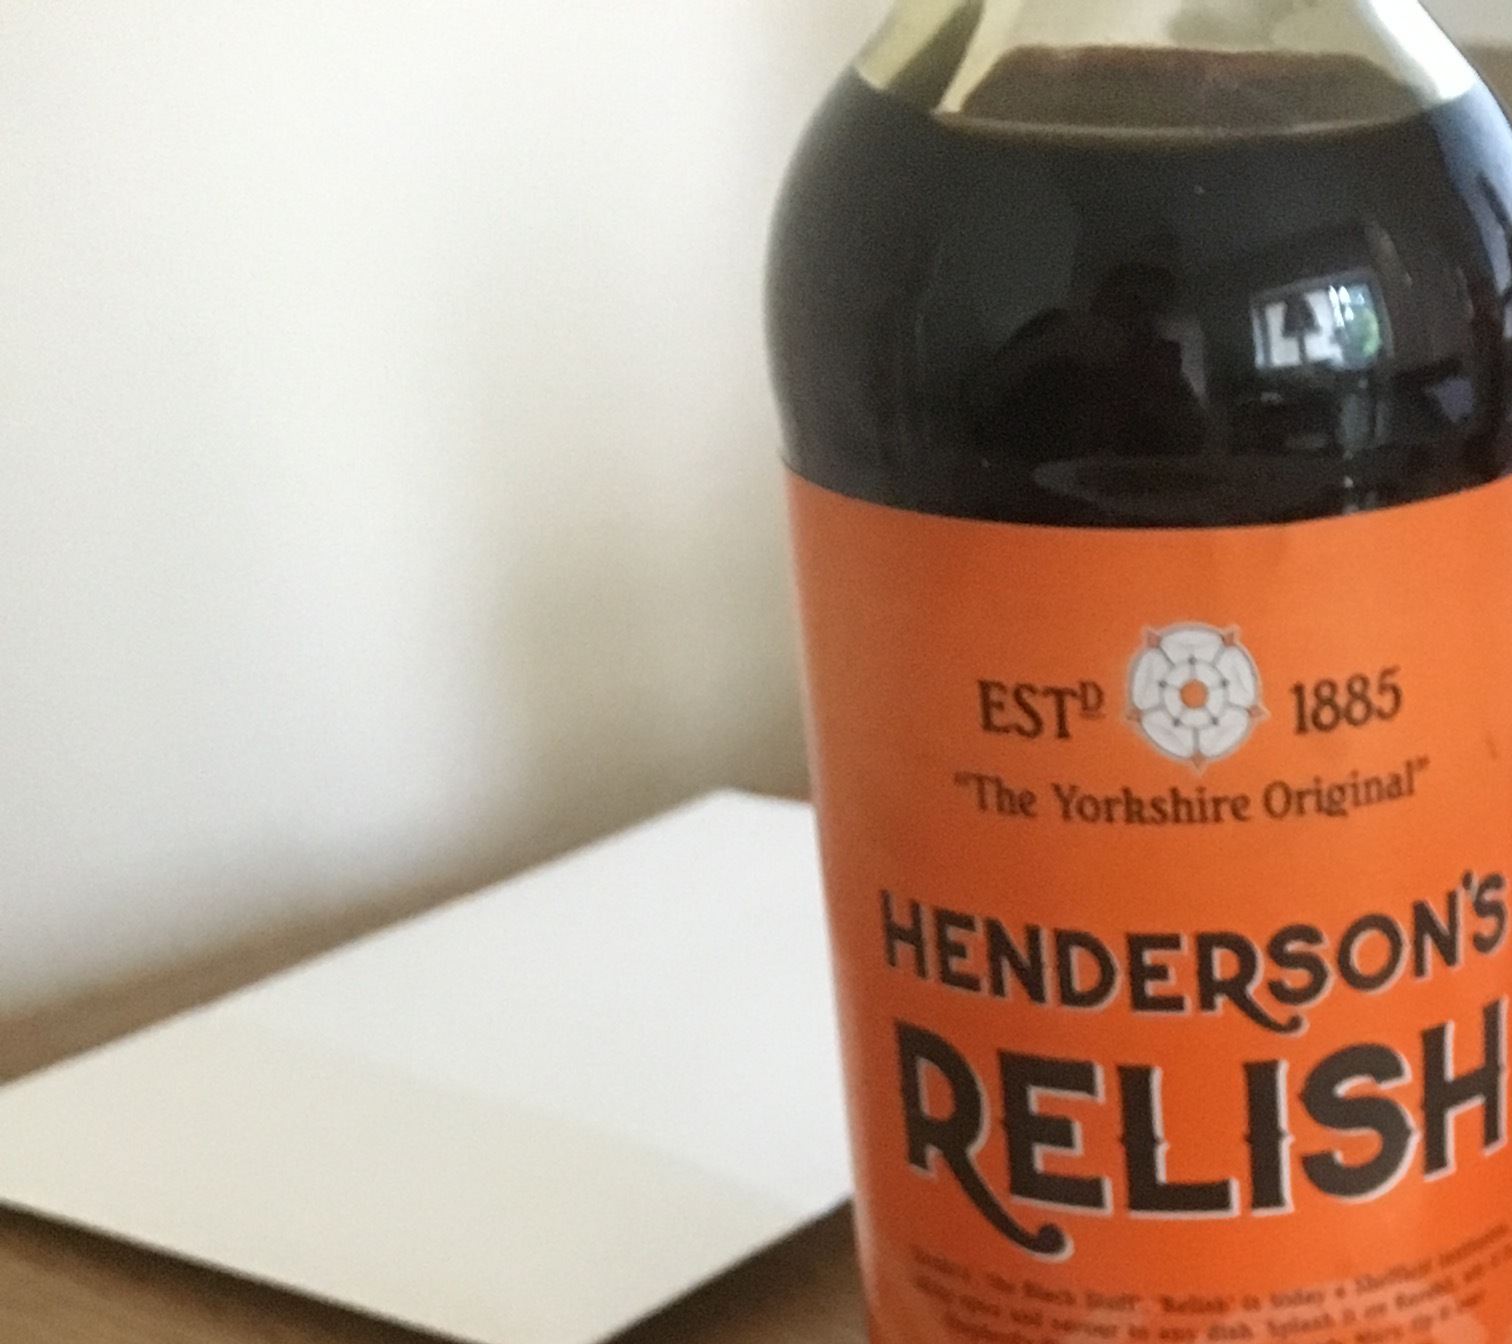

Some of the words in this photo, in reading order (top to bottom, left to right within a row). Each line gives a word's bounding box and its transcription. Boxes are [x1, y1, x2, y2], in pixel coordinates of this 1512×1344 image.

[1291, 666, 1402, 736] 1885
[1050, 782, 1252, 827] Yorkshire
[878, 868, 1511, 1034] HENDERSON'S
[893, 993, 1509, 1261] RELISH
